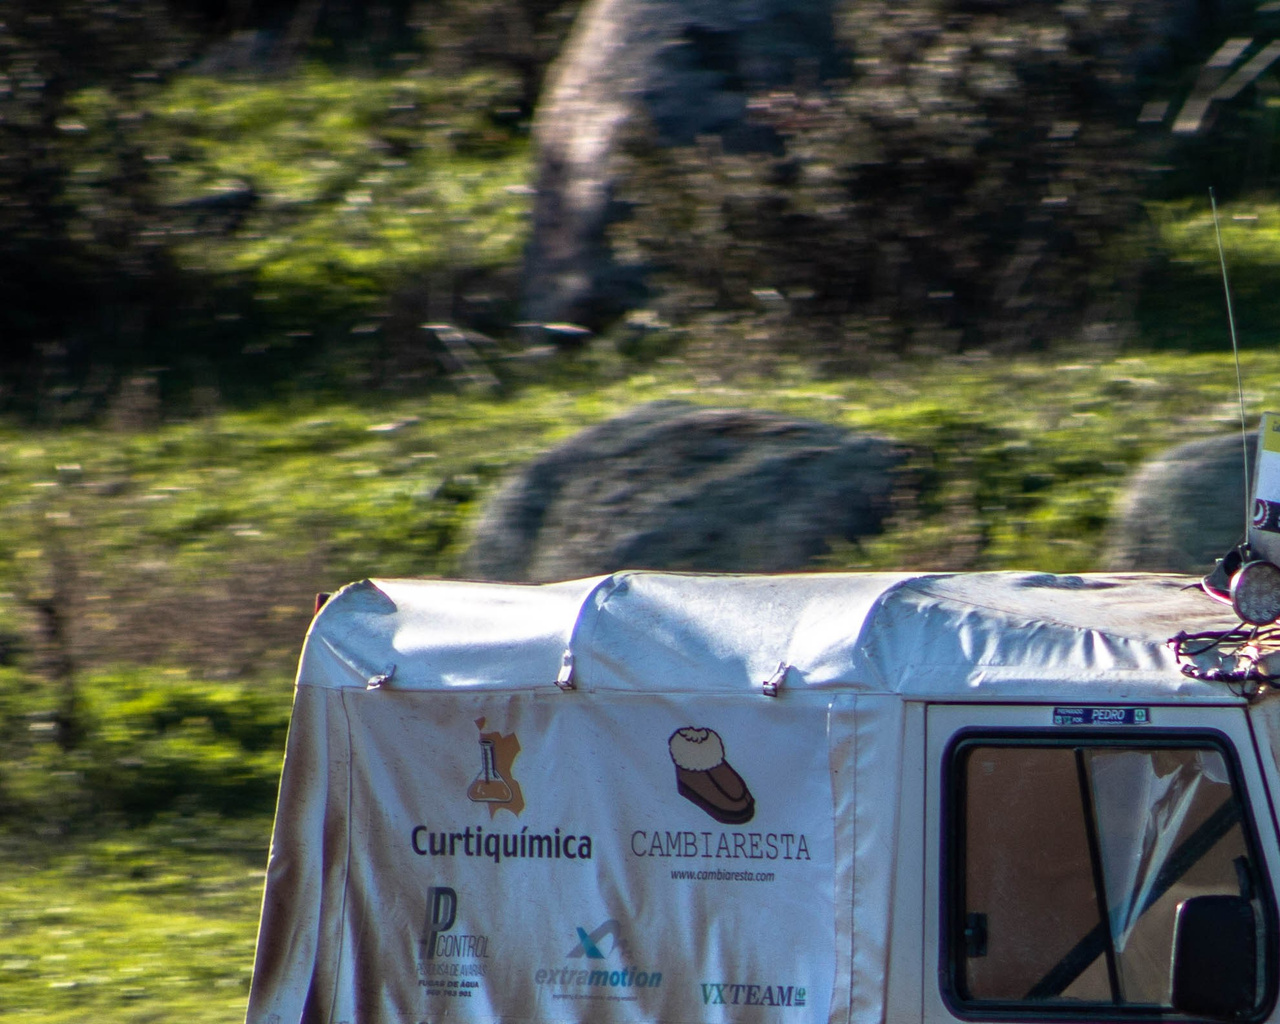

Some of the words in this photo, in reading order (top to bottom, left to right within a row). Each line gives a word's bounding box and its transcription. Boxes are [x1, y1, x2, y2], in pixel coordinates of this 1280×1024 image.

[1091, 709, 1125, 720] PEDRO
[411, 825, 592, 863] Curtiquímica
[631, 831, 811, 861] CAMBIARESTA
[671, 869, 775, 882] www.cambiaresta.com
[436, 934, 490, 958] CONTROL
[535, 966, 662, 987] extramotion
